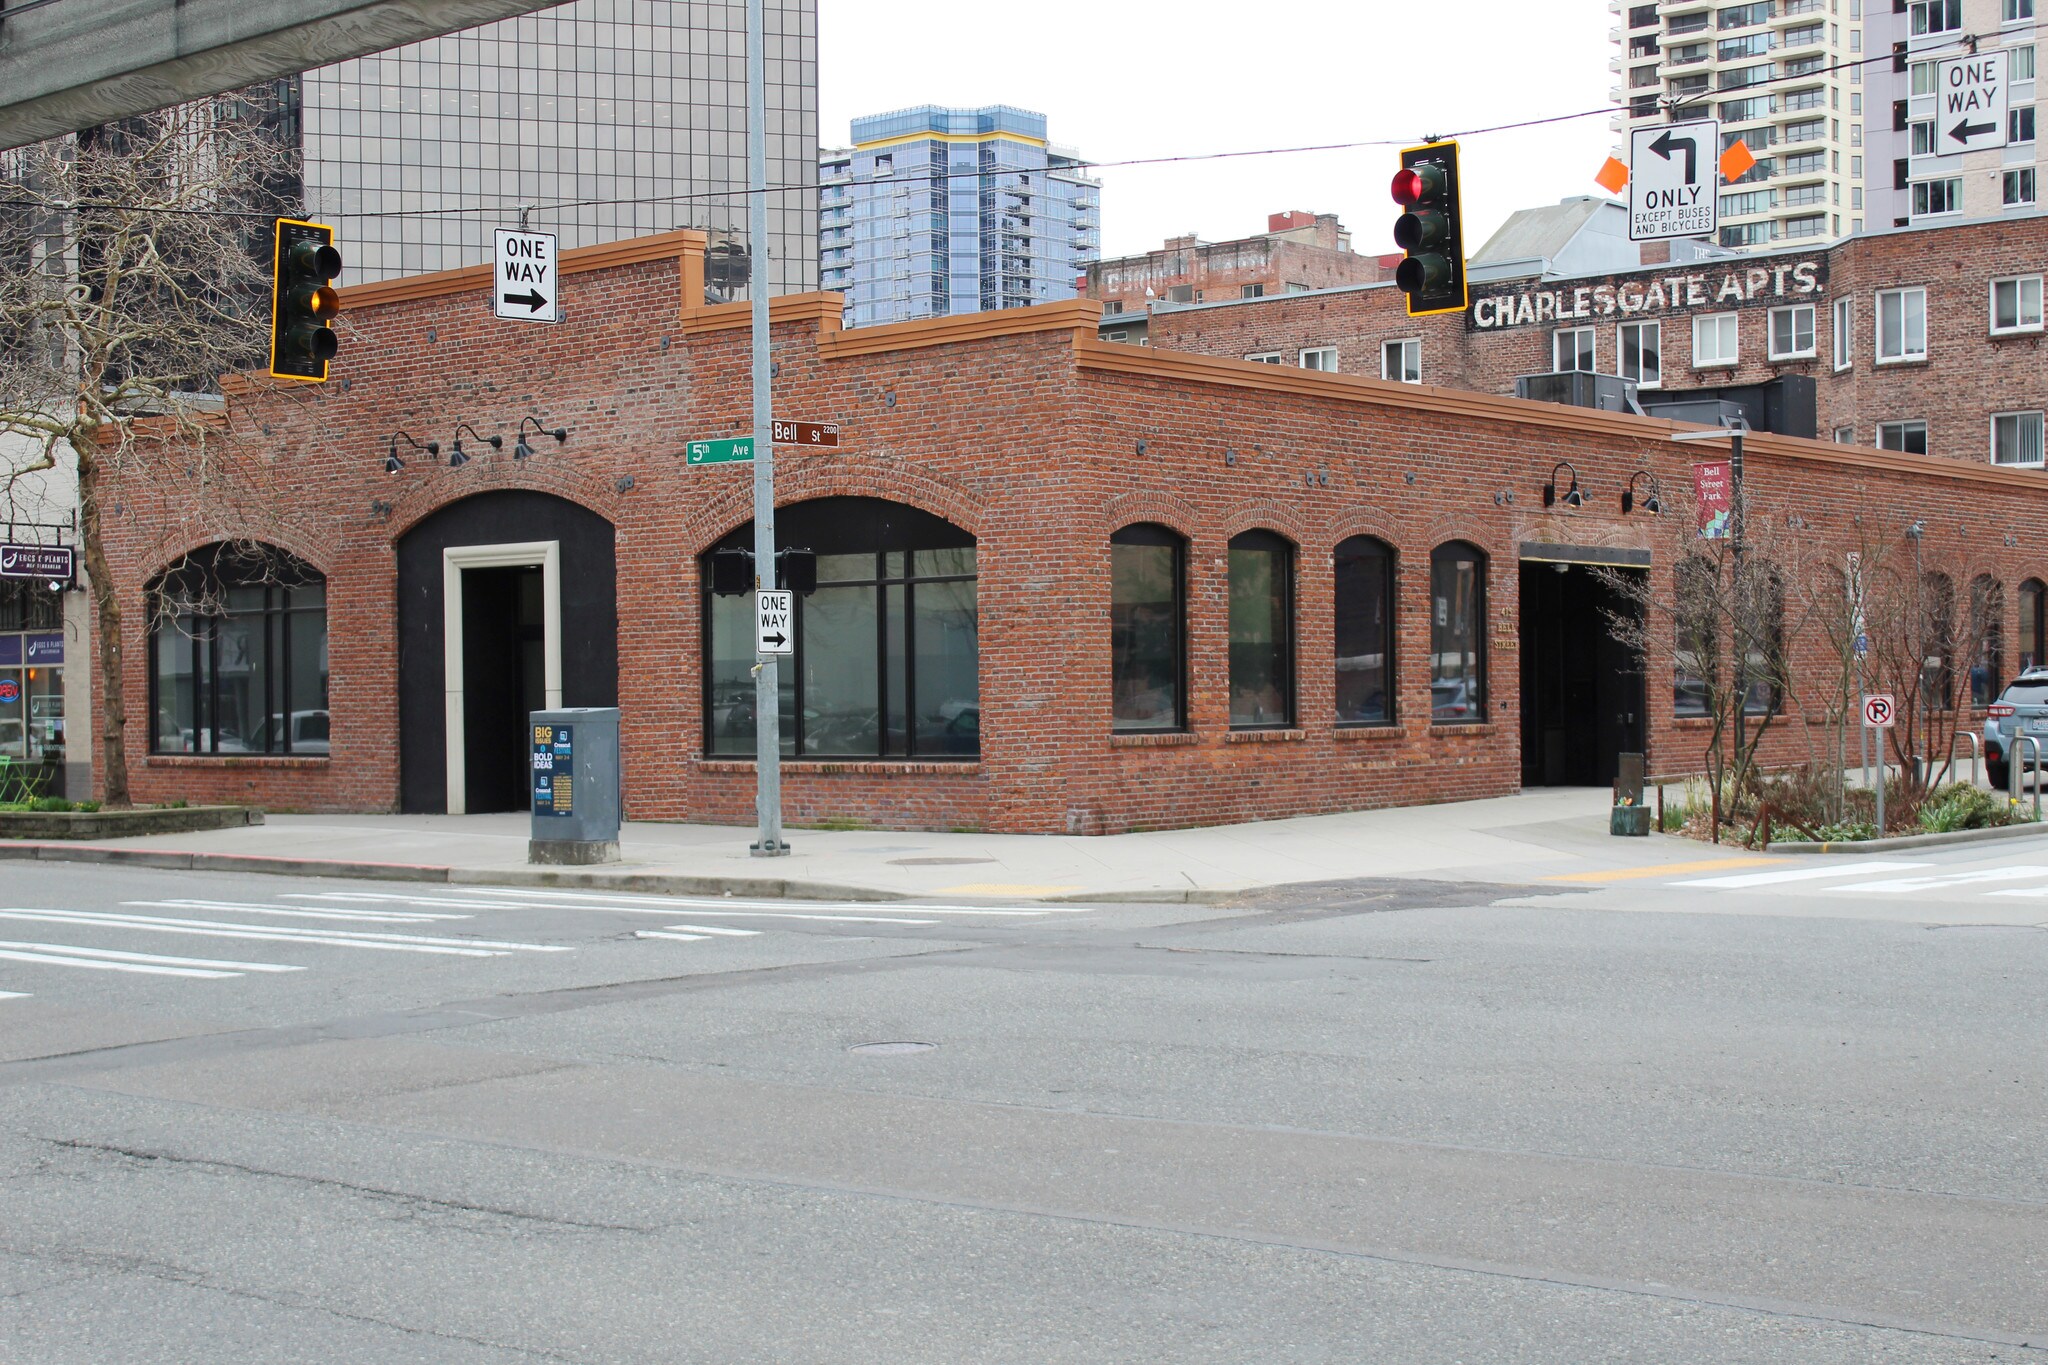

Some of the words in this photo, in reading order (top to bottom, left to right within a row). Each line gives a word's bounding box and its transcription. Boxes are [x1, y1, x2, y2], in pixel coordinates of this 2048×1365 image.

[1950, 60, 1996, 87] ONE
[1948, 87, 1997, 114] WAY
[1646, 186, 1701, 209] ONLY
[1635, 211, 1672, 224] EXCEPT
[1678, 206, 1711, 219] BUSES
[1635, 223, 1656, 235] AND
[1661, 218, 1710, 233] BICYCLES
[506, 238, 546, 259] ONE
[505, 261, 547, 283] WAY
[1474, 273, 1706, 328] CHARLESGATE
[1716, 262, 1824, 303] APTS.
[774, 422, 797, 441] Bell
[811, 430, 821, 442] St
[823, 425, 837, 435] 2200
[692, 444, 710, 462] 5th
[732, 443, 749, 456] Ave
[1703, 467, 1720, 476] Bell
[1700, 480, 1724, 489] Street
[1703, 491, 1722, 501] Park
[19, 553, 36, 563] EGGS
[44, 555, 69, 564] PLANTS
[761, 596, 787, 611] ONE
[761, 613, 787, 628] WAY
[1497, 622, 1515, 632] BELL
[1494, 640, 1517, 649] STREET
[0, 684, 18, 697] PEN
[535, 726, 552, 738] BIG
[534, 752, 553, 761] BOLD
[534, 761, 553, 769] IDEAS
